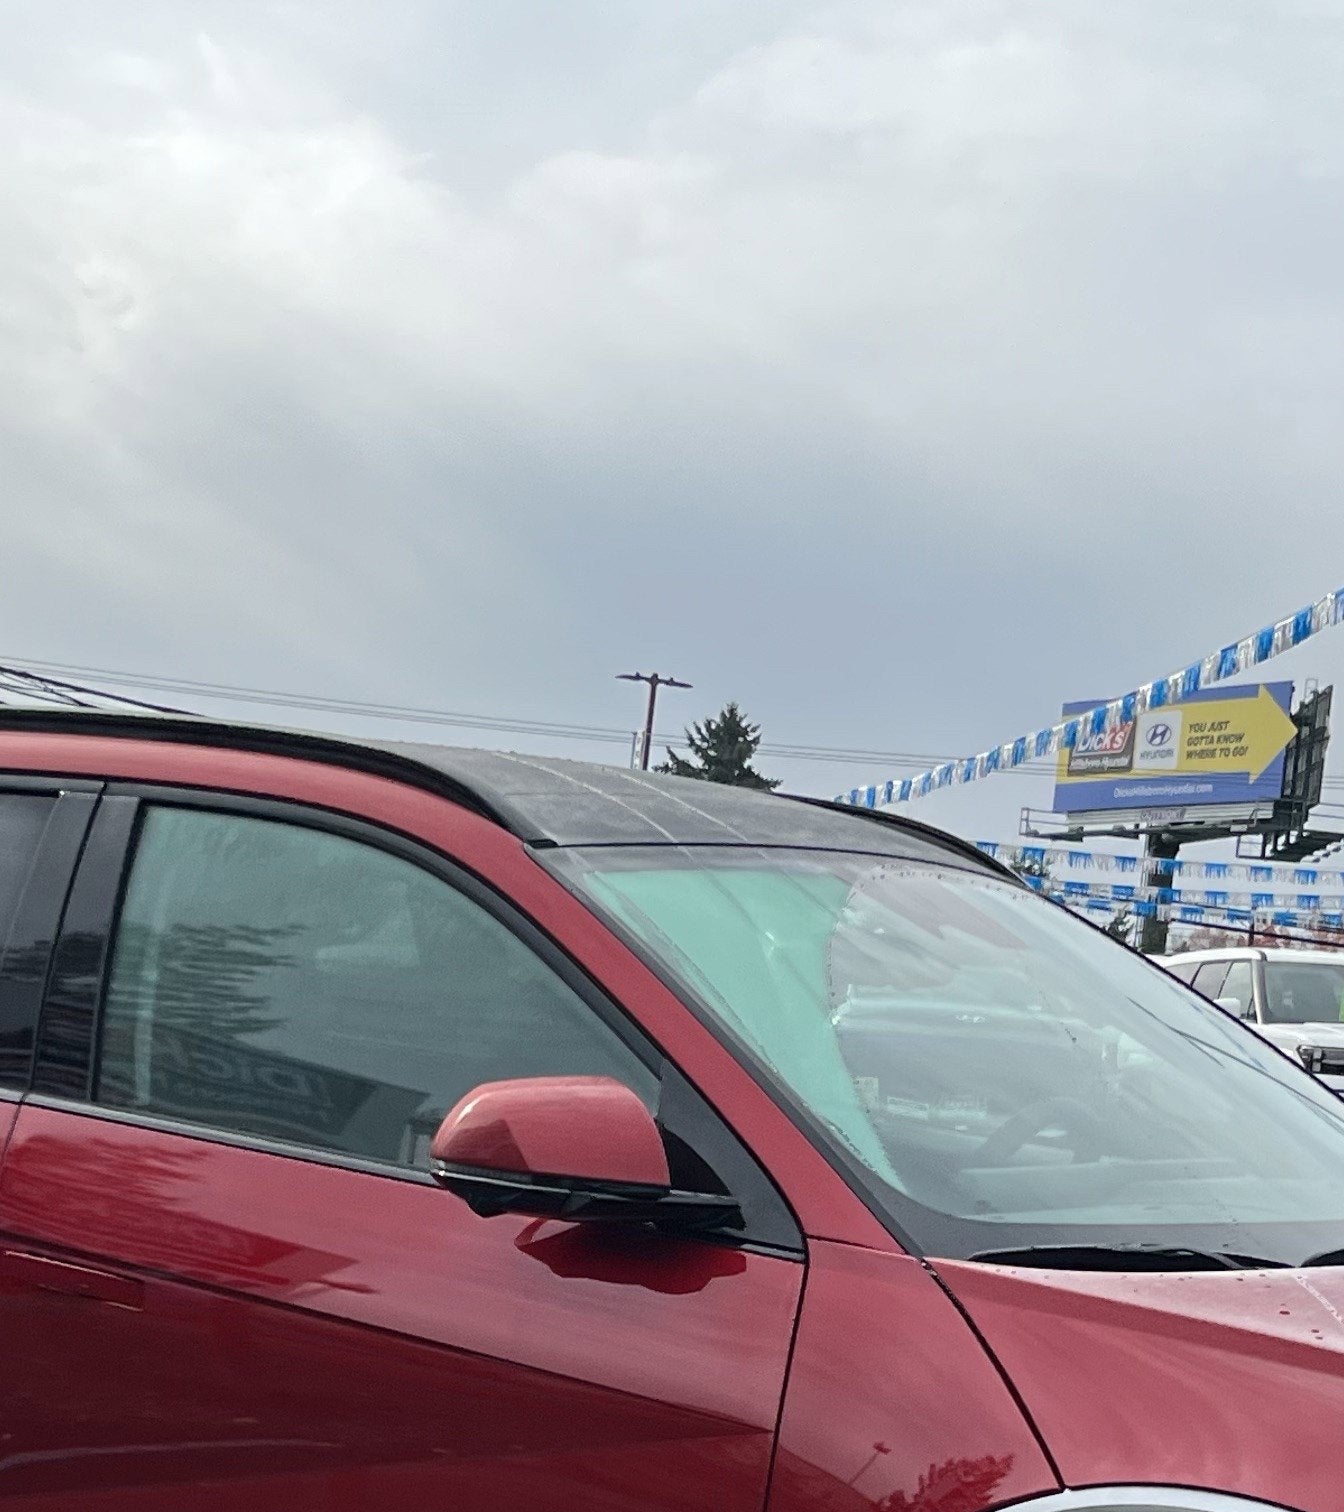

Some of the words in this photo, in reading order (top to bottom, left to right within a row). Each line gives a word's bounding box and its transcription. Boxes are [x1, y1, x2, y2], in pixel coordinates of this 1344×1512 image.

[1188, 722, 1208, 733] YOU
[1208, 720, 1231, 732] JUST
[1187, 734, 1215, 746] GOTTA
[1216, 733, 1245, 744] KNOW
[1186, 748, 1217, 760] WHERE
[1218, 747, 1231, 757] TO
